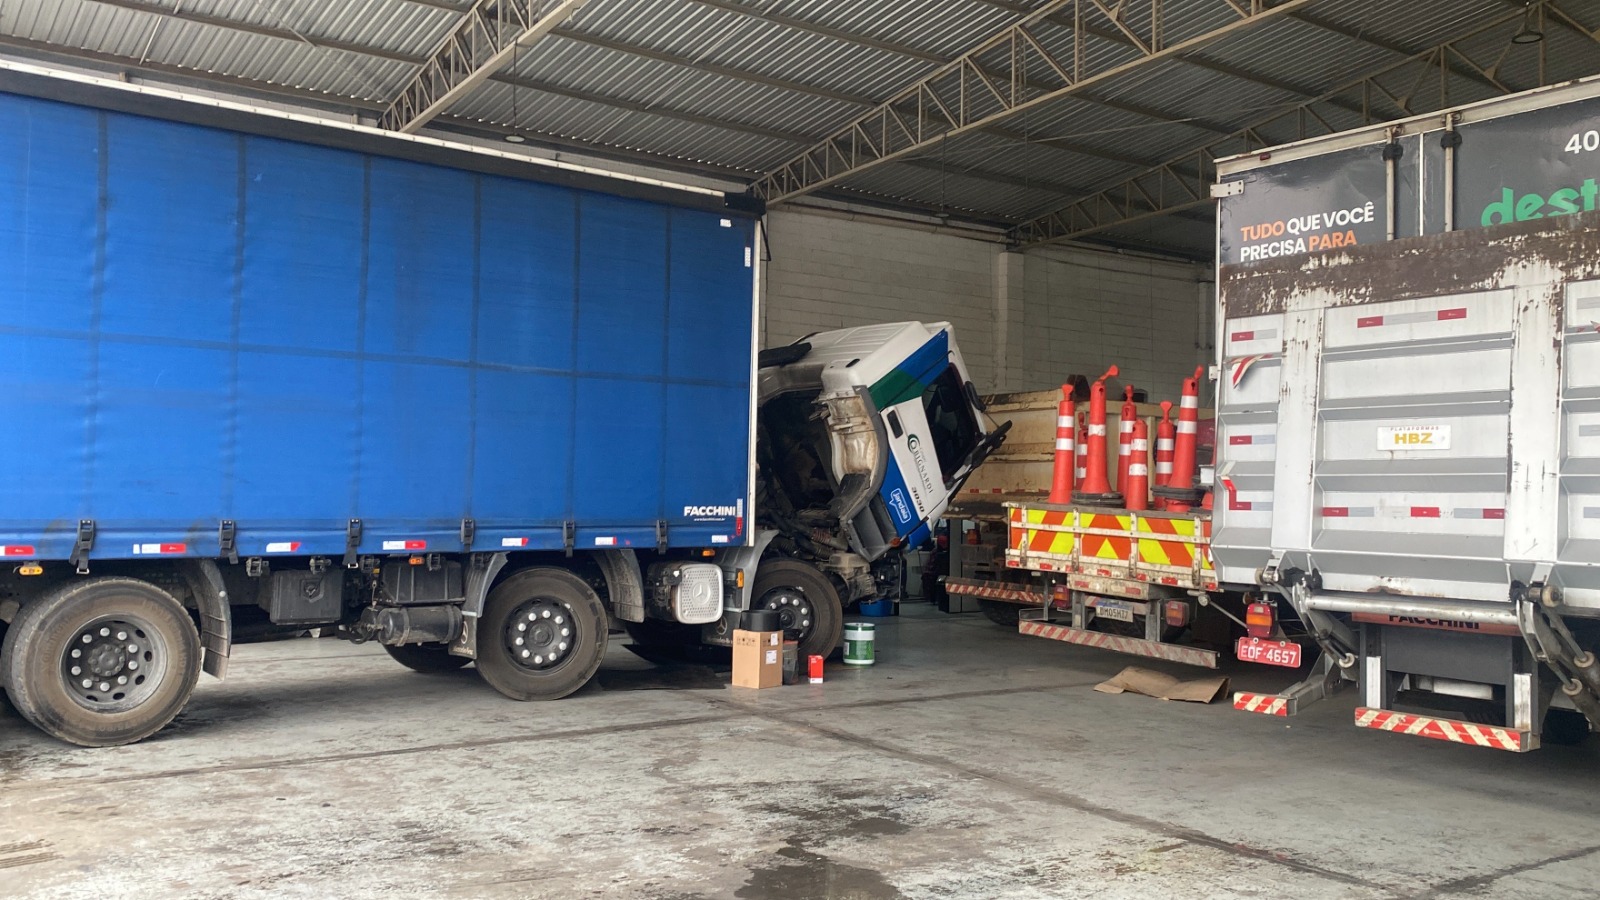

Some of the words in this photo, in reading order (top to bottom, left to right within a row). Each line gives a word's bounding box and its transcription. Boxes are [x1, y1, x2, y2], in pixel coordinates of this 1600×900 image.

[1564, 130, 1600, 154] 40
[1481, 178, 1600, 227] dest
[1240, 220, 1285, 241] TUDO
[1286, 214, 1320, 235] QUE
[1323, 201, 1375, 228] VOCÊ
[1240, 238, 1306, 262] PRECISA
[1308, 230, 1357, 252] PARA
[1394, 432, 1433, 445] HBZ
[684, 505, 736, 517] FACCHINI
